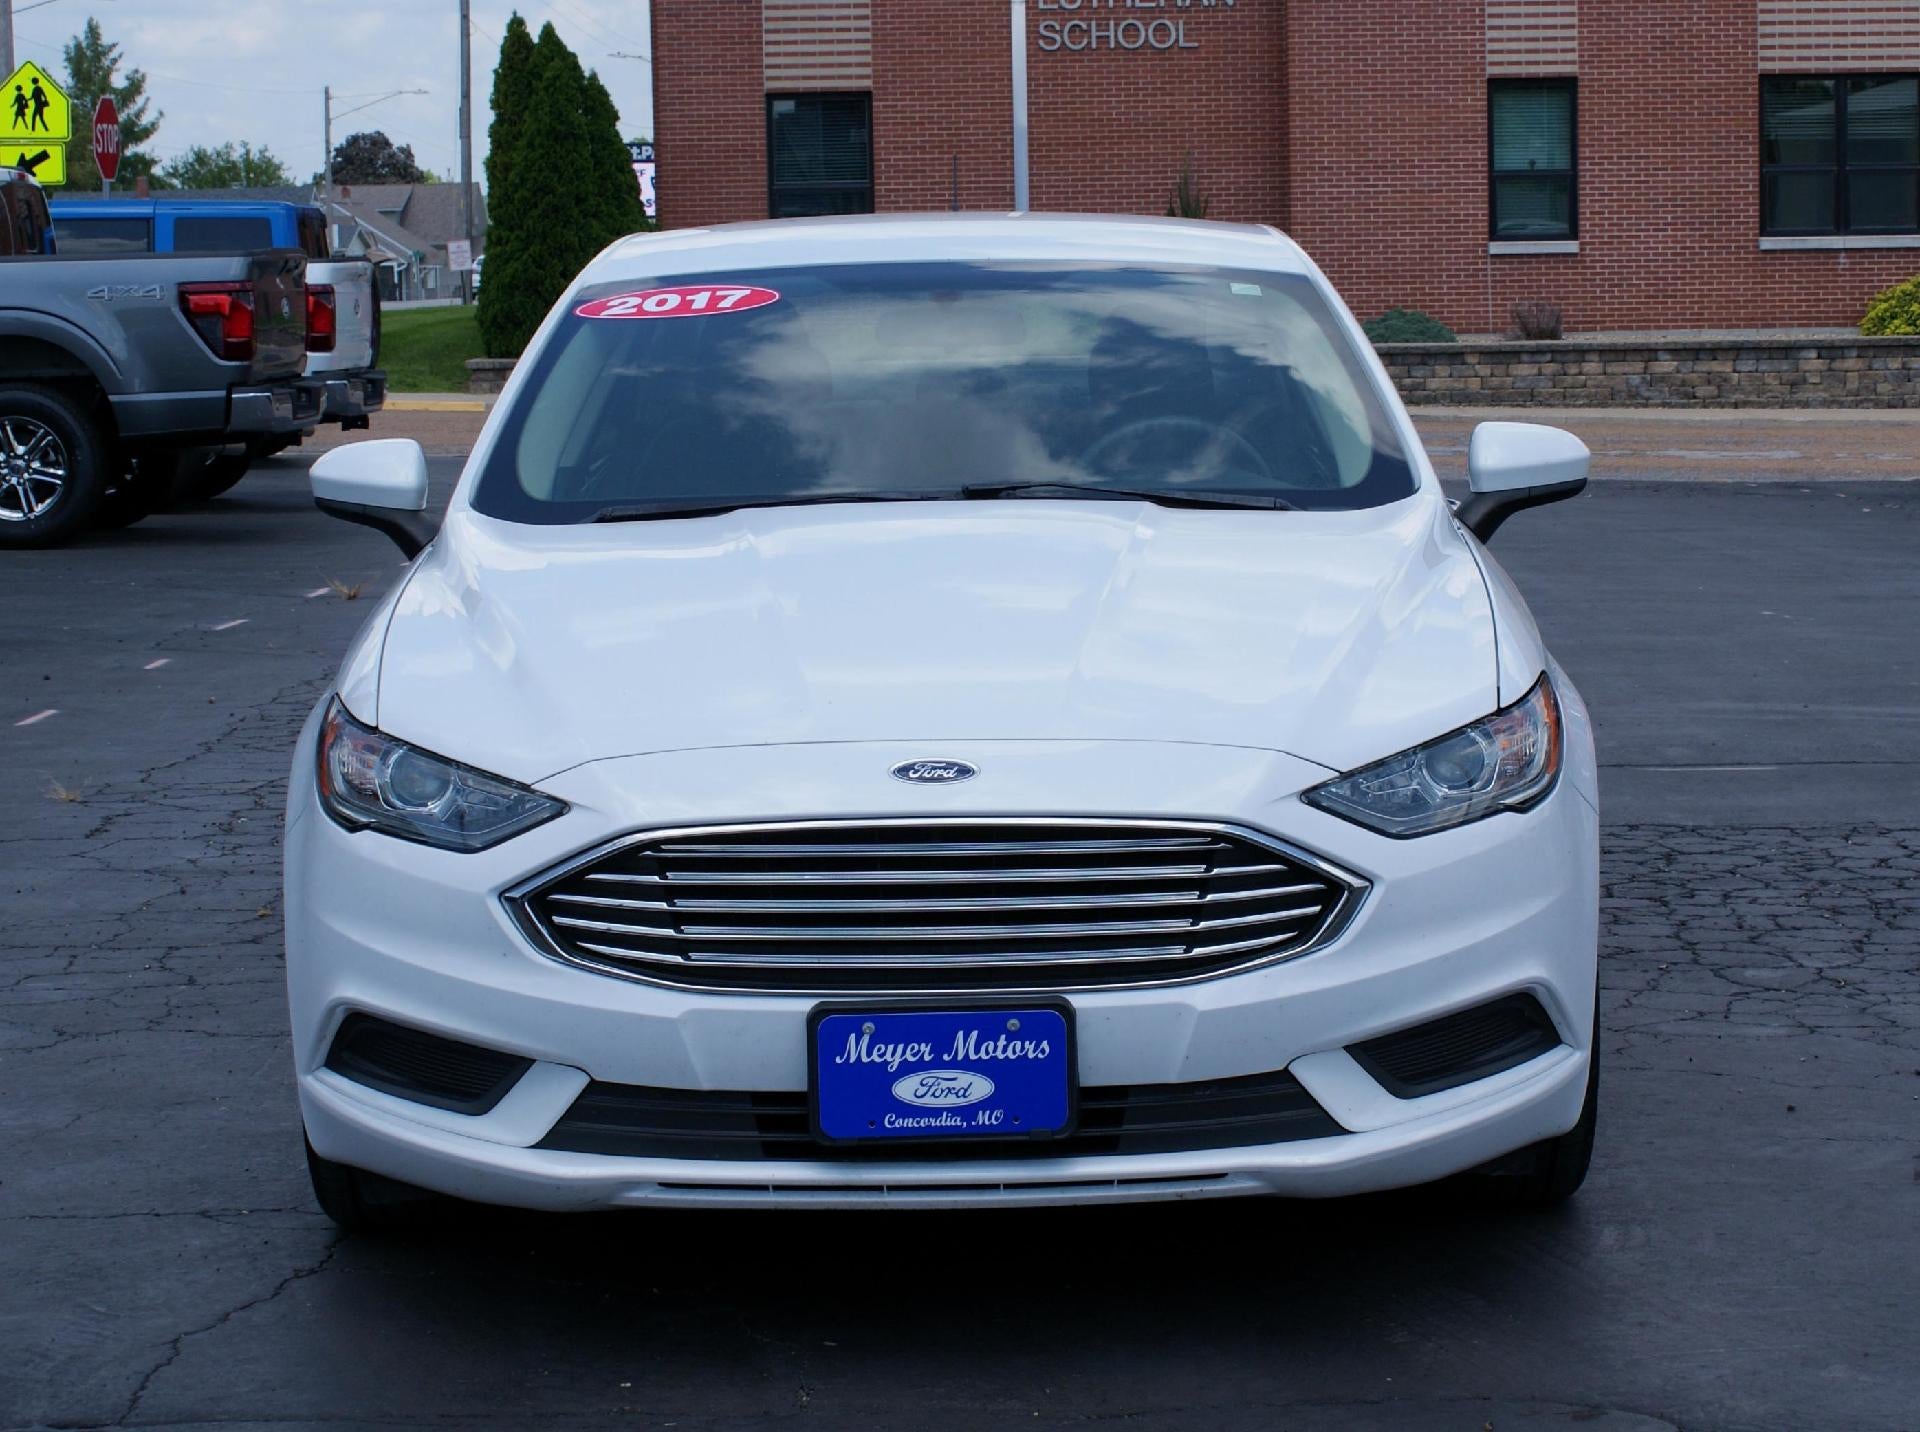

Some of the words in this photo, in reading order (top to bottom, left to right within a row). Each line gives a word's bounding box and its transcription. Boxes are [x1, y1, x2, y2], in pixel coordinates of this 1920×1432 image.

[1038, 18, 1199, 51] SCHOOL
[96, 123, 119, 154] STOP
[600, 289, 752, 316] 2017
[909, 762, 959, 778] Ford
[835, 1032, 934, 1072] Meyer
[943, 1030, 1050, 1062] Motors
[914, 1076, 973, 1099] Ford
[884, 1112, 967, 1129] Concordia,
[971, 1109, 1004, 1126] MO
